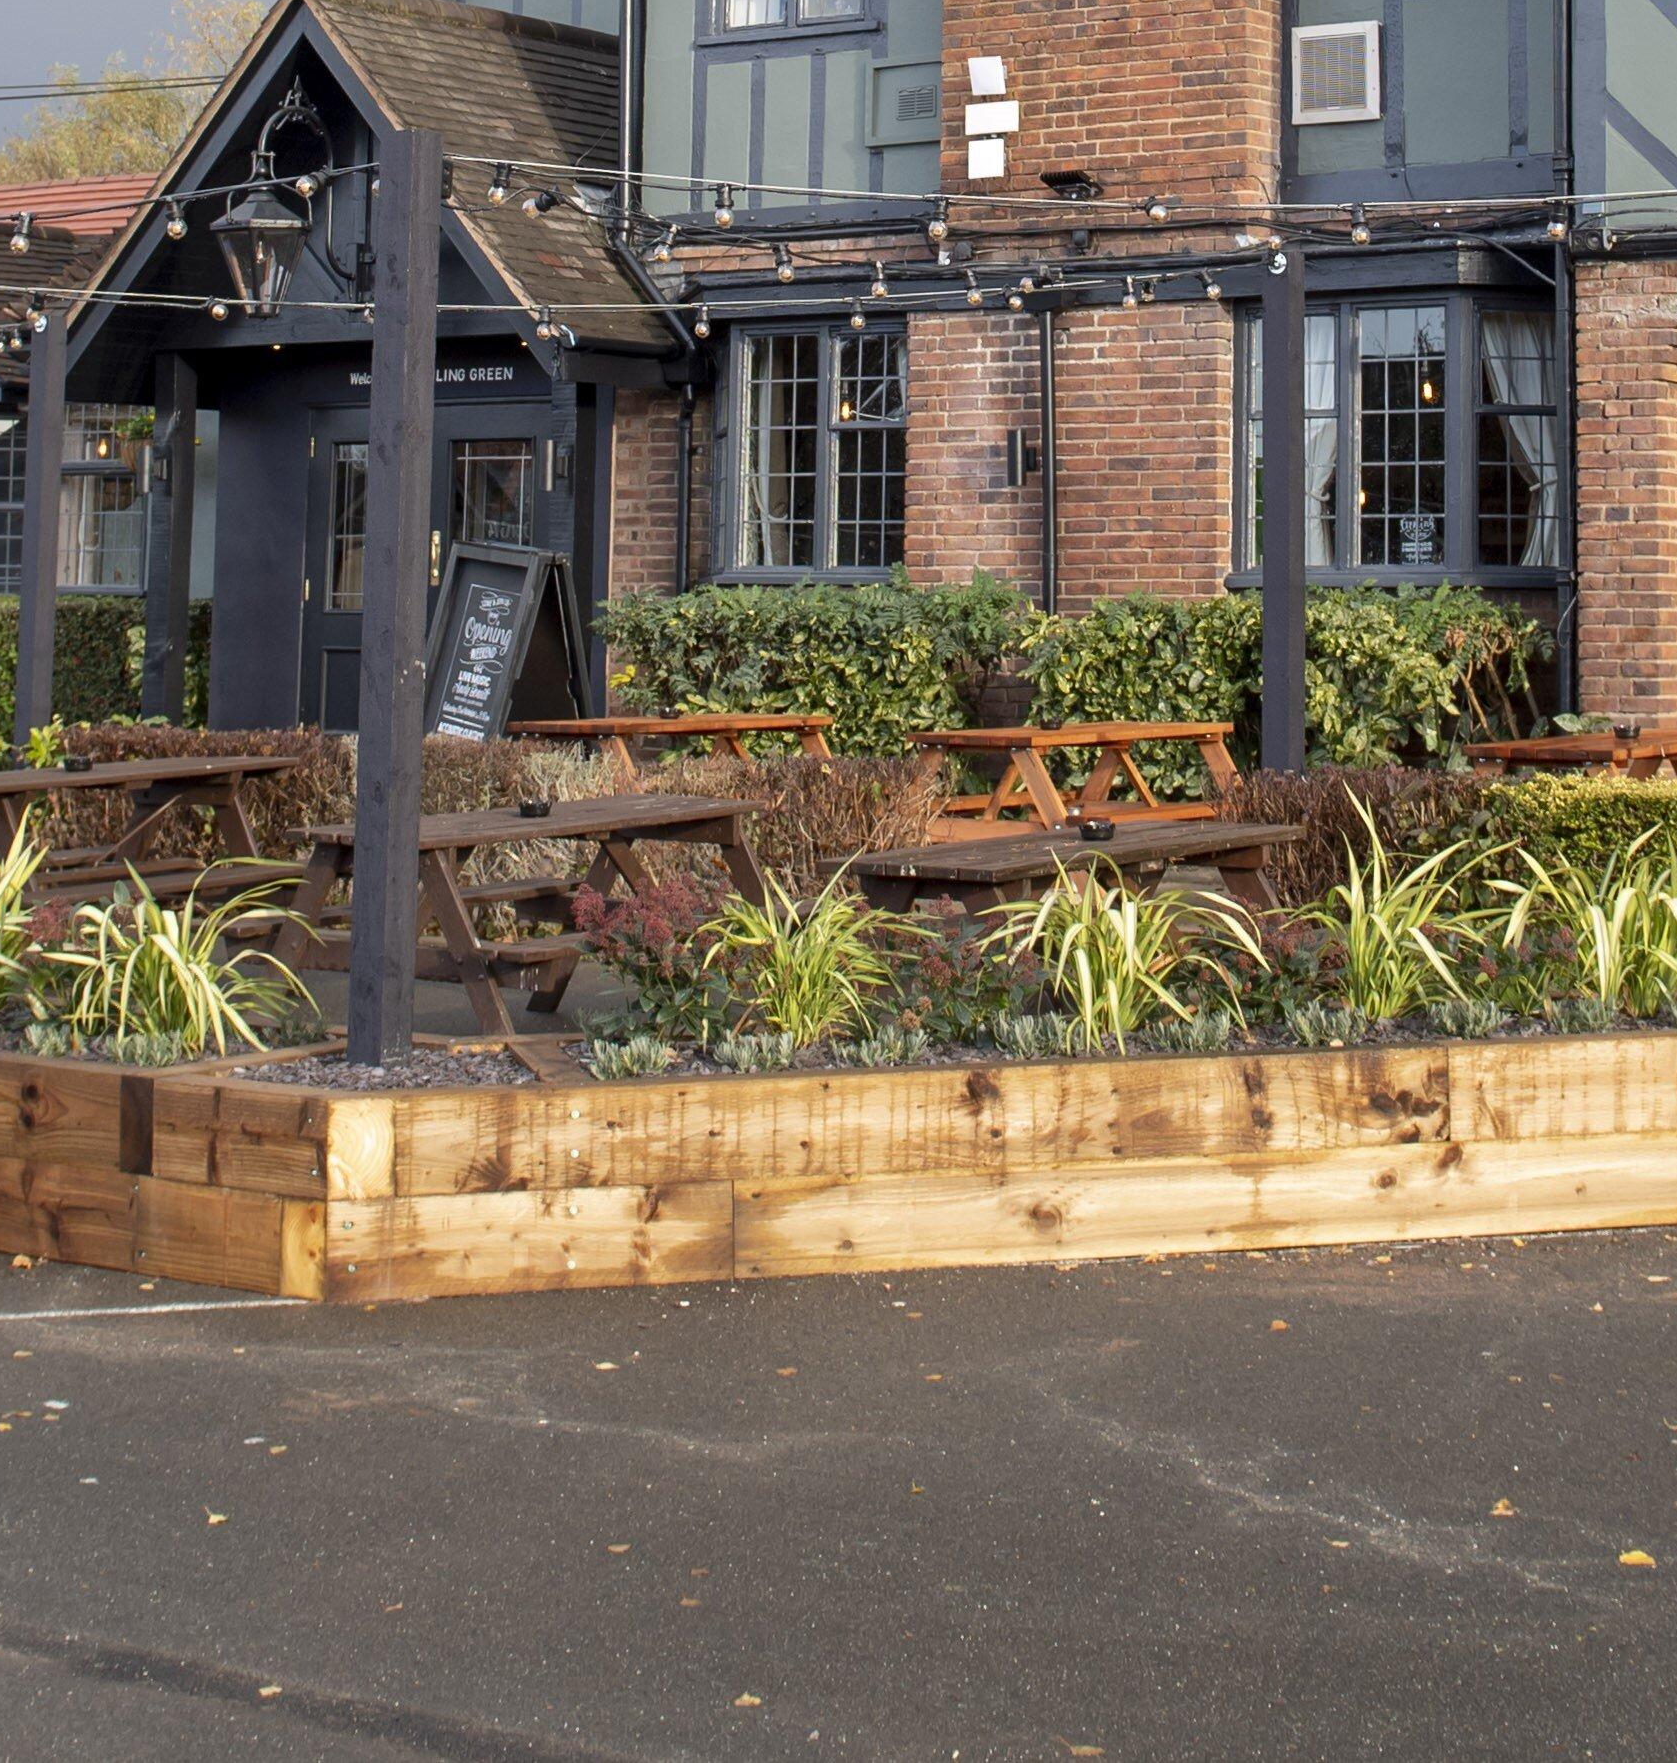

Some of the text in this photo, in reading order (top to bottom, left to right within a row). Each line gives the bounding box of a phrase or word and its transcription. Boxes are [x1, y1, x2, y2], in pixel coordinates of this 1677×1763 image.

[349, 366, 514, 385] Welc LING GREEN
[464, 616, 513, 655] Opening
